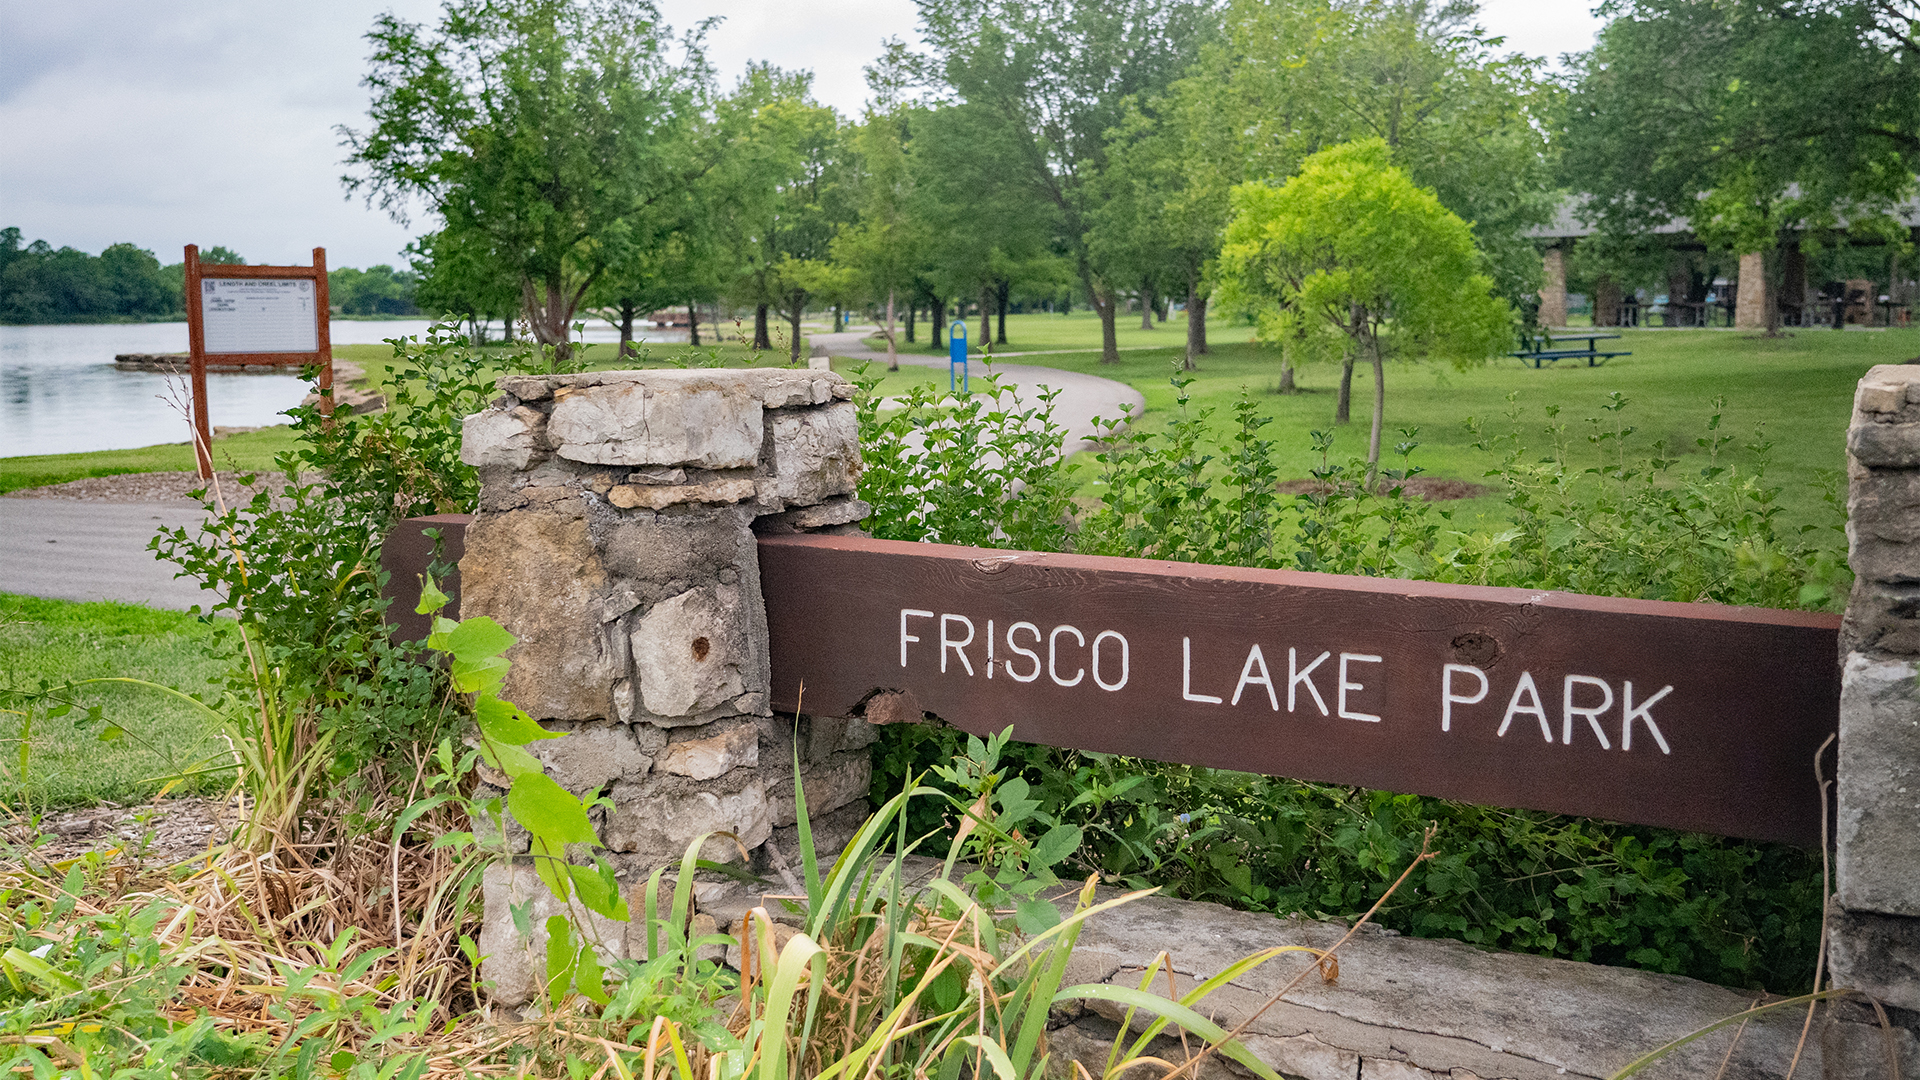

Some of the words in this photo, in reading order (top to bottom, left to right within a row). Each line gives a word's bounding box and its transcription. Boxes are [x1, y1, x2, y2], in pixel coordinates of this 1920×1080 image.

[900, 608, 1130, 692] FRISCO
[1182, 636, 1383, 723] LAKE
[1441, 663, 1674, 755] PARK
